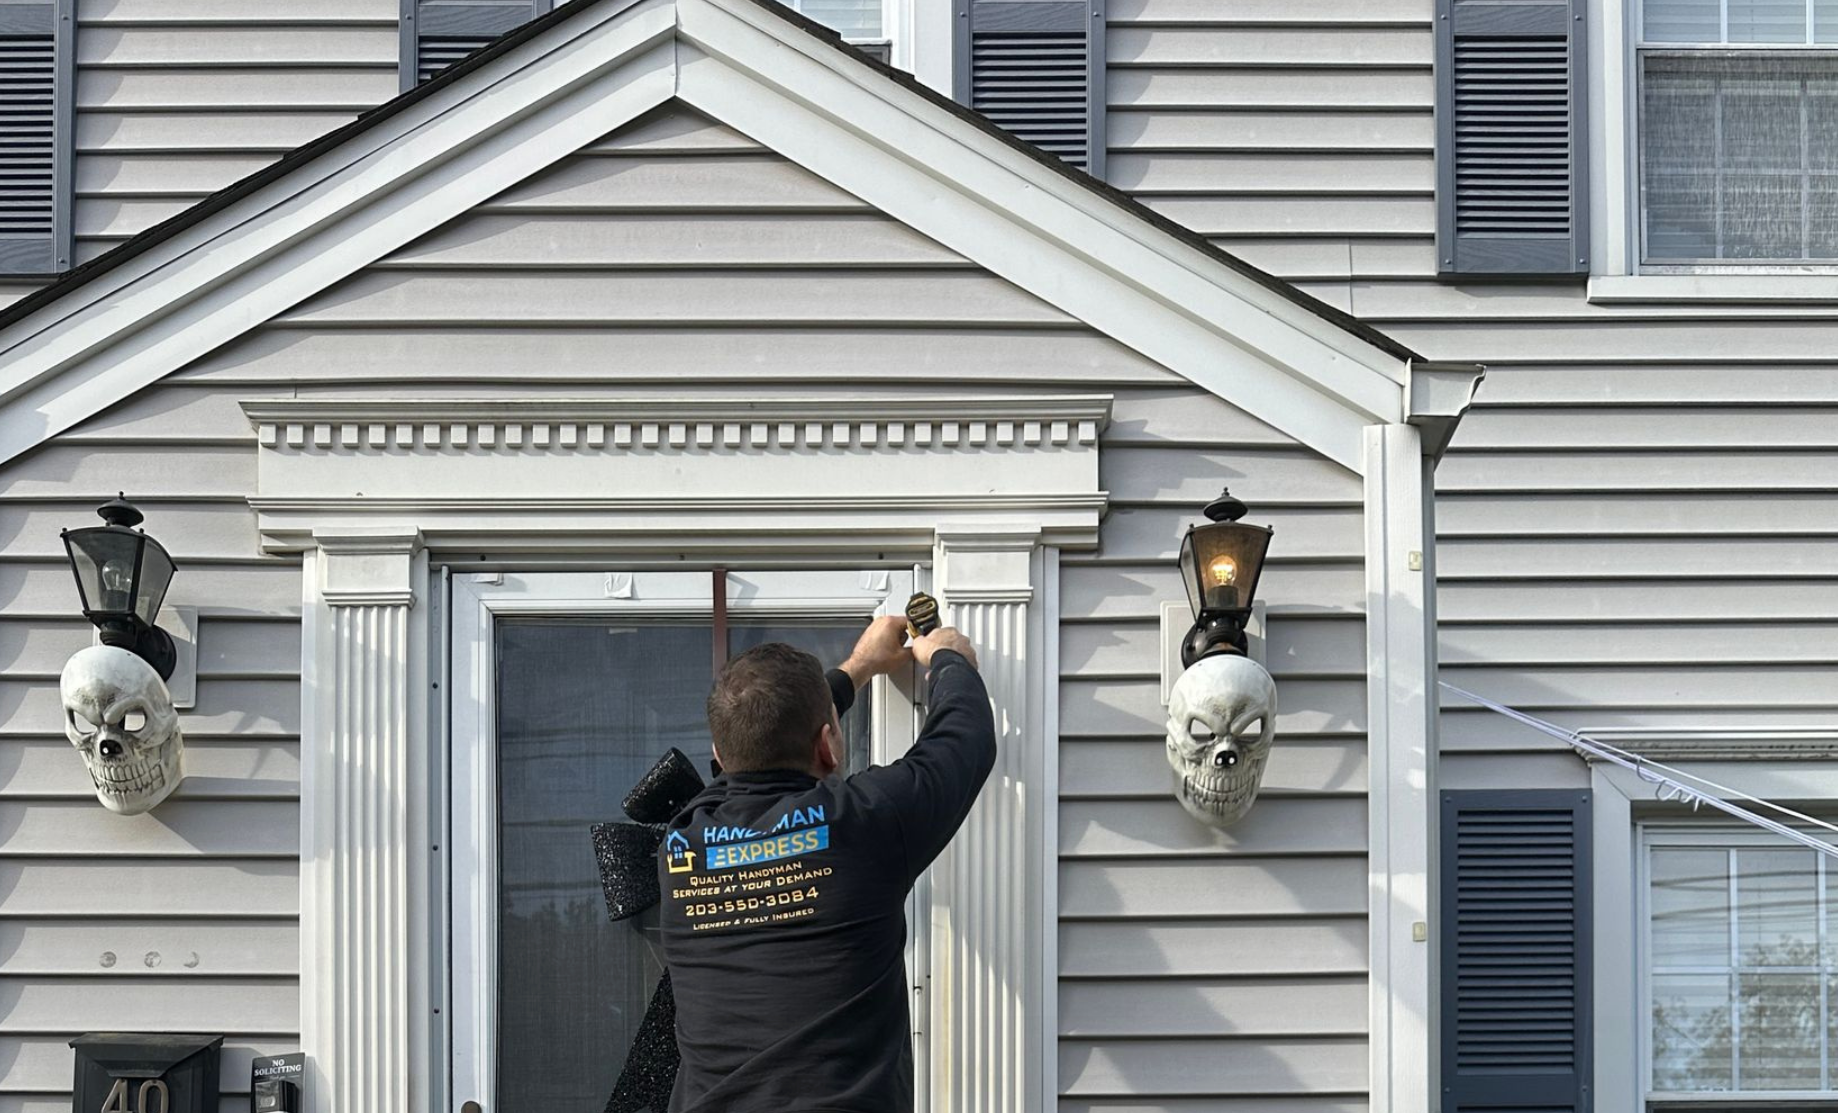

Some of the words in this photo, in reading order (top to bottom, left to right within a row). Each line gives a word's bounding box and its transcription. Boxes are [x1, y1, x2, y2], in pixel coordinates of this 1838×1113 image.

[727, 830, 820, 866] EXPRESS
[672, 886, 721, 899] SERVICES
[723, 884, 739, 894] AT
[741, 879, 772, 892] YOUR
[776, 867, 833, 886] DEMAND
[689, 874, 734, 887] QUALITY
[738, 861, 803, 881] HANDYMAN
[685, 886, 820, 917] 203-550-3084
[733, 918, 741, 926] &
[743, 915, 770, 925] FULLY
[772, 907, 815, 922] INSURED
[254, 1064, 303, 1077] SOLICITING
[272, 1058, 285, 1067] NO
